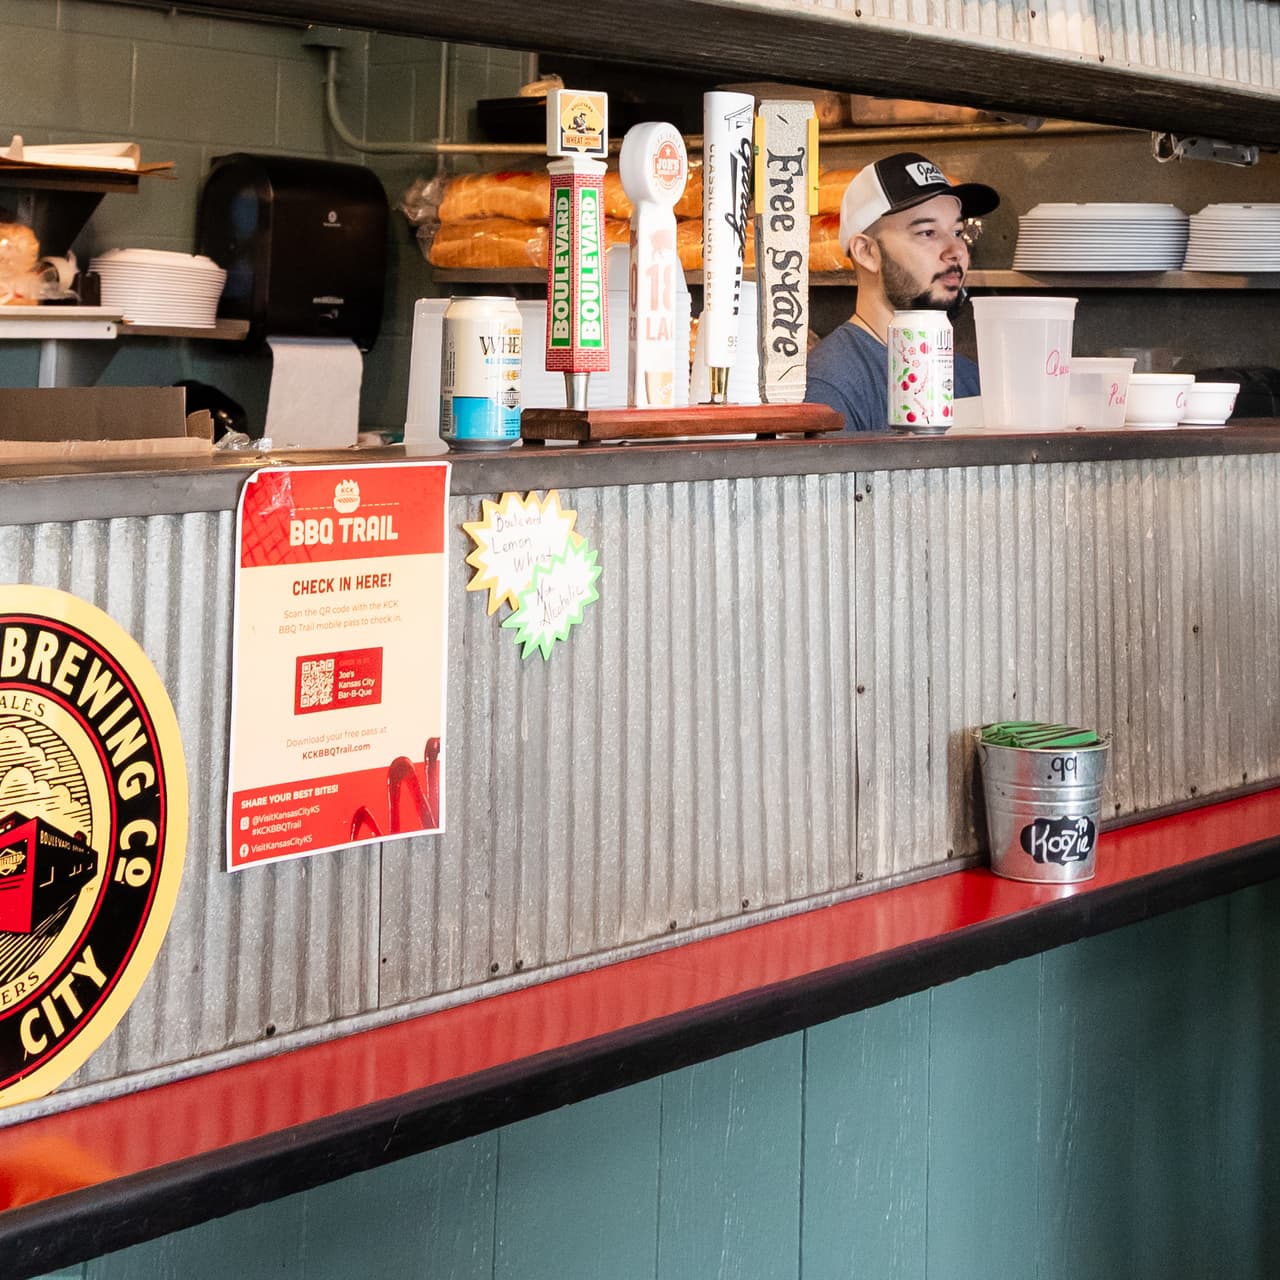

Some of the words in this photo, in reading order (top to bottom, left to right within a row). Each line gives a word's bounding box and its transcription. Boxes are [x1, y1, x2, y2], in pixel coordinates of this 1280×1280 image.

[767, 147, 806, 232] Free
[551, 196, 571, 341] BOULEVARD
[580, 196, 599, 338] BOULEVARD
[767, 247, 804, 357] State
[480, 336, 521, 355] WHE
[290, 518, 334, 547] BBQ
[338, 515, 399, 544] TRAIL
[492, 537, 532, 554] Lemon
[292, 577, 335, 596] CHECK
[339, 576, 351, 591] IN
[355, 572, 392, 590] HERE!
[338, 680, 361, 690] Kansas
[338, 689, 372, 700] Bar-B-Que
[0, 626, 158, 801] BREWING
[286, 734, 325, 749] Download
[302, 743, 371, 760] KCKBBQTrail.com
[241, 796, 268, 809] SHARE
[269, 792, 292, 804] YOUR
[293, 788, 313, 800] BEST
[21, 942, 109, 1058] CITY
